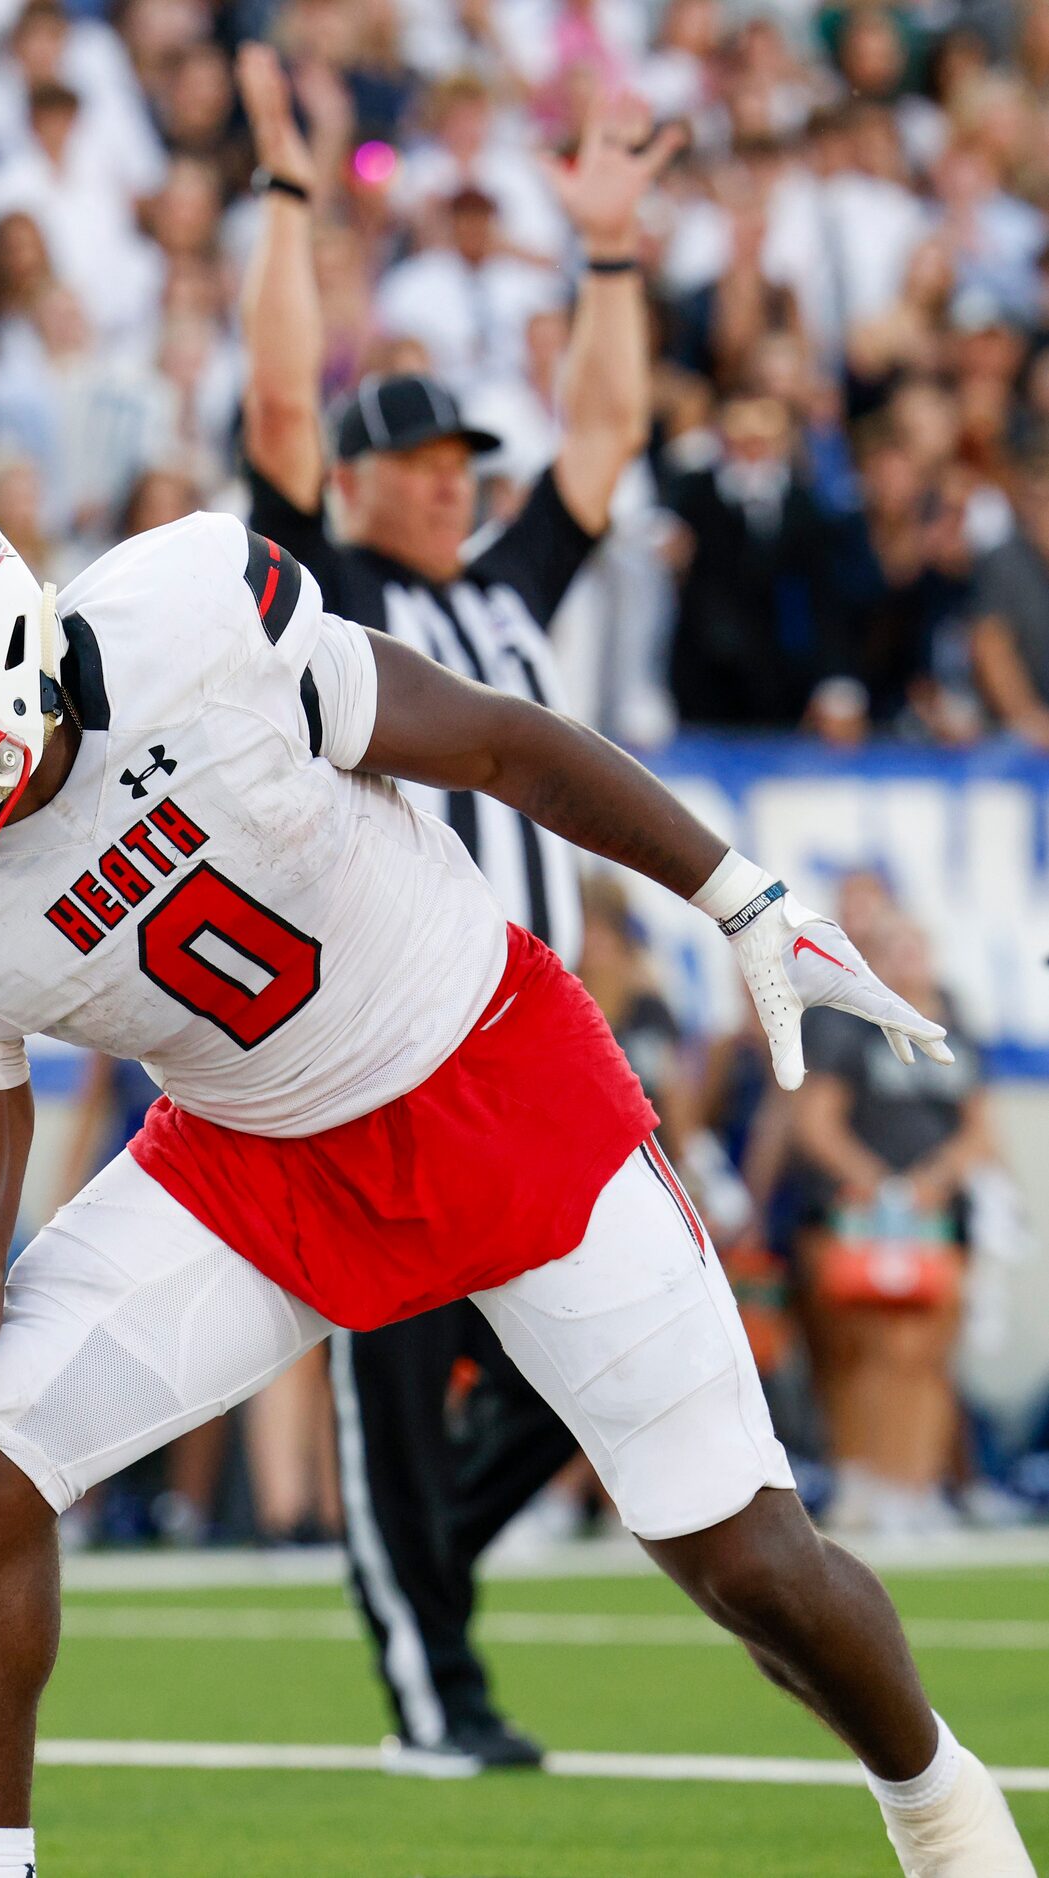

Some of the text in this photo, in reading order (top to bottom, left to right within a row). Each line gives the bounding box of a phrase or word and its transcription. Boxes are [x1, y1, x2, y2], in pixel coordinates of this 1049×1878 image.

[44, 796, 211, 956] HEATH
[136, 859, 323, 1052] 0
[725, 885, 783, 934] PHILIPPIANS 4:13
